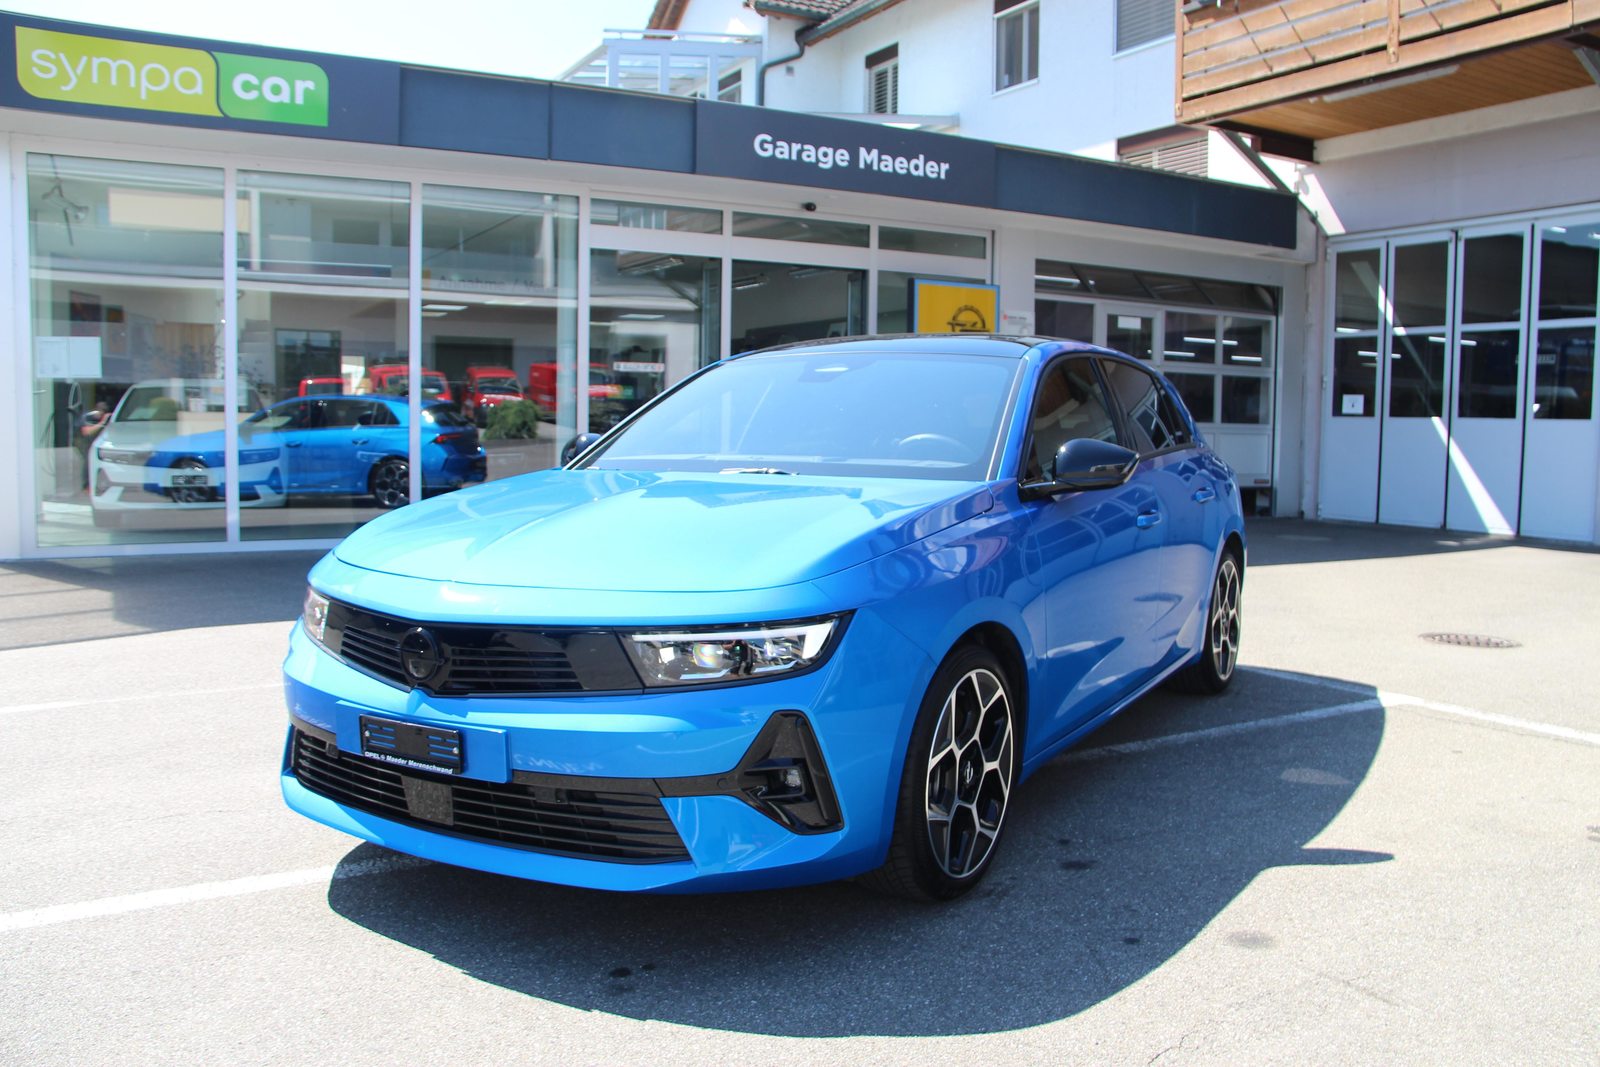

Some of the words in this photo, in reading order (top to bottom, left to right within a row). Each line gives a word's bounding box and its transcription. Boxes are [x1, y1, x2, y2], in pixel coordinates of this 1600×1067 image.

[30, 49, 204, 101] sympa
[232, 72, 315, 105] car
[753, 133, 850, 169] Garage
[858, 146, 950, 180] Maeder
[386, 755, 407, 764] Maeder
[408, 760, 453, 774] Merenschwand
